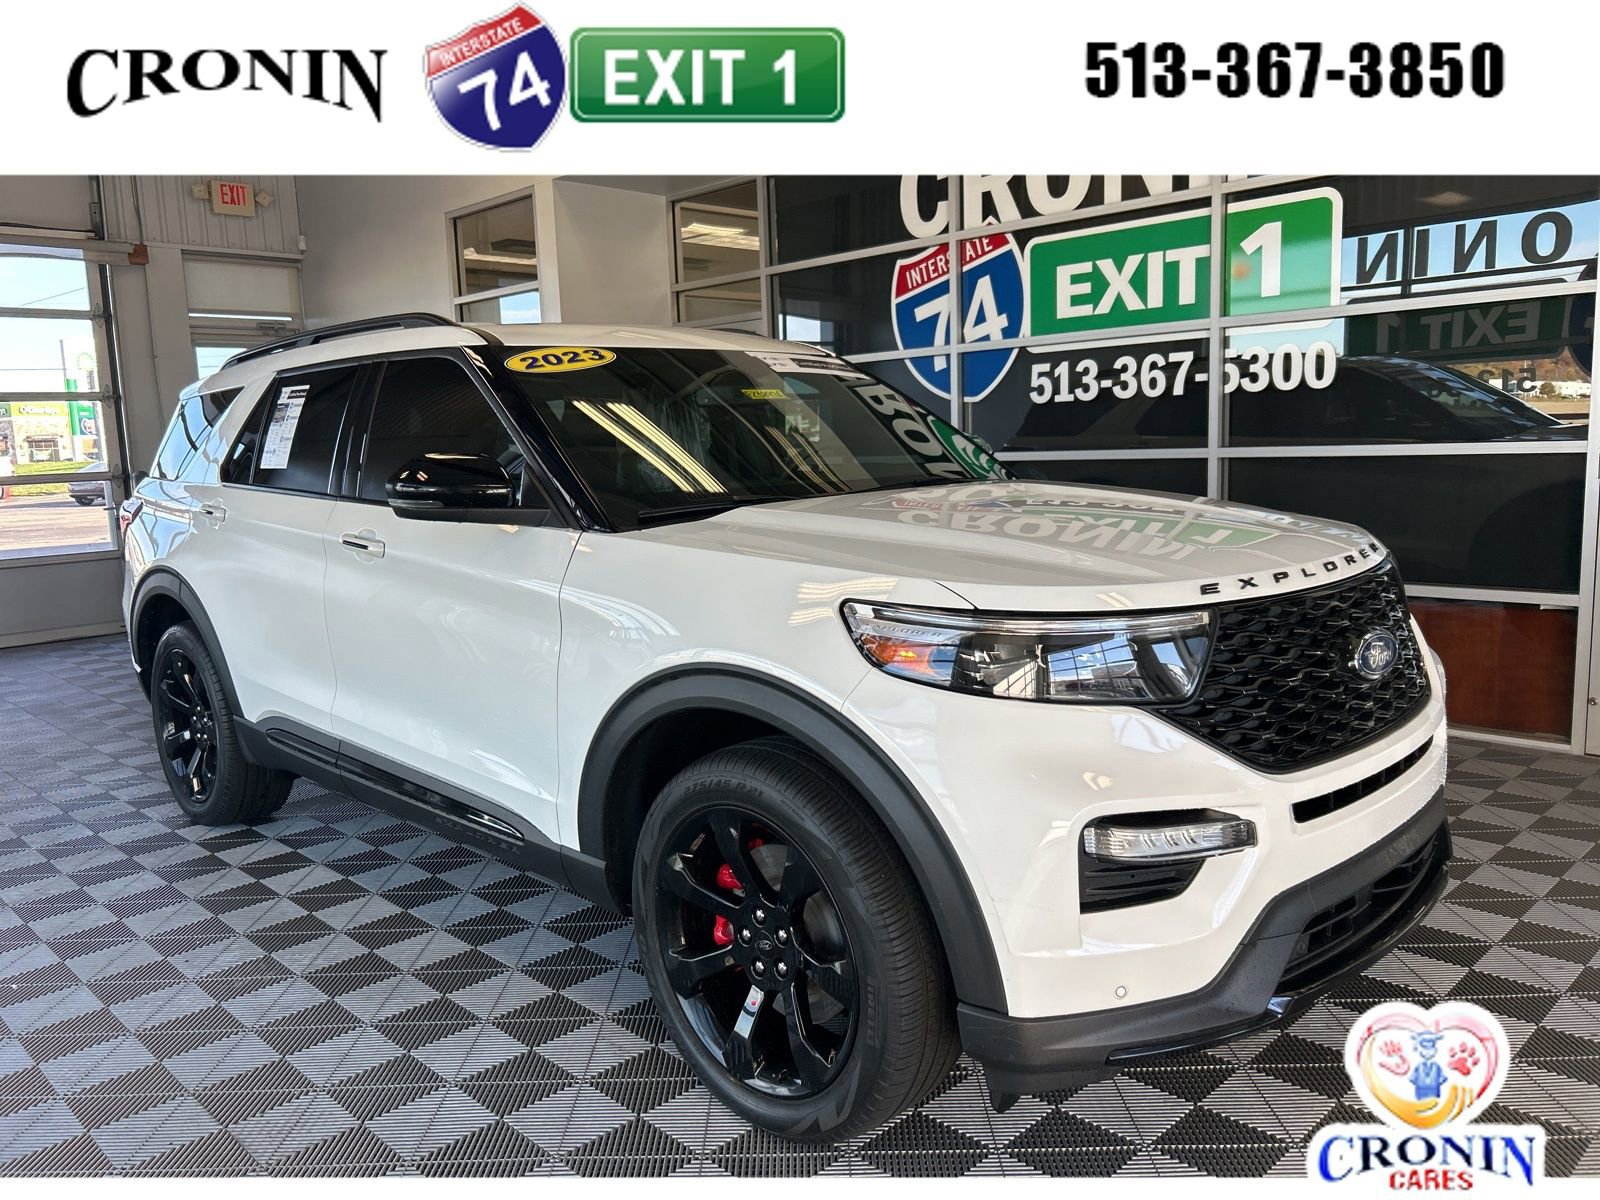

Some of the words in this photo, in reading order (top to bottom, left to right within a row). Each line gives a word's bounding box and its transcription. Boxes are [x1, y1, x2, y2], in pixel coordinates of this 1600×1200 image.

[220, 183, 247, 207] EXIT
[906, 237, 993, 289] INTERATE
[1056, 244, 1210, 320] EXIT
[1240, 221, 1282, 298] 1
[914, 275, 1009, 372] 74
[519, 349, 606, 370] 2023
[1200, 542, 1379, 596] EXPLORER
